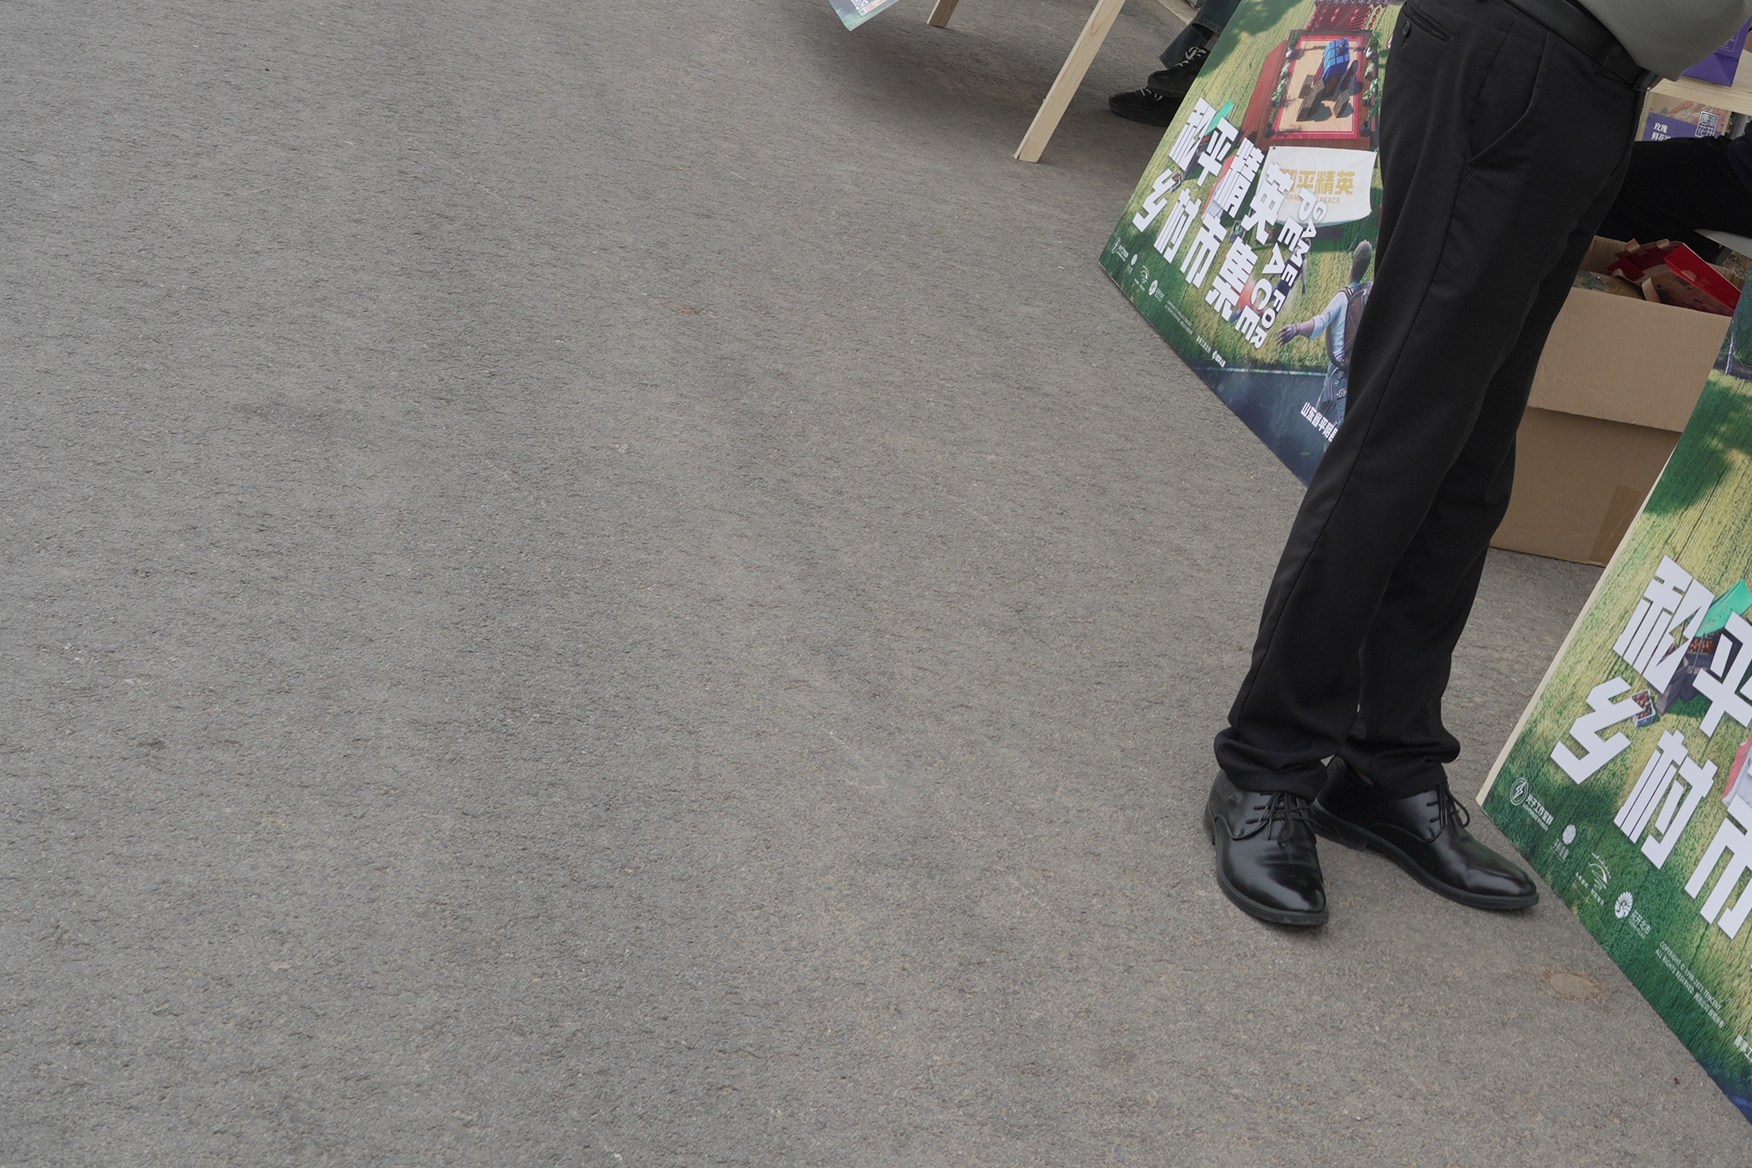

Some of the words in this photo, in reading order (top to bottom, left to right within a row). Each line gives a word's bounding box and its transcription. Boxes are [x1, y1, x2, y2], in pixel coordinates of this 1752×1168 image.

[1168, 97, 1294, 245] 和平精英
[1281, 201, 1328, 287] GAME
[1132, 168, 1259, 323] 乡村市集
[1235, 187, 1318, 341] PEACE
[1250, 288, 1287, 349] FOR
